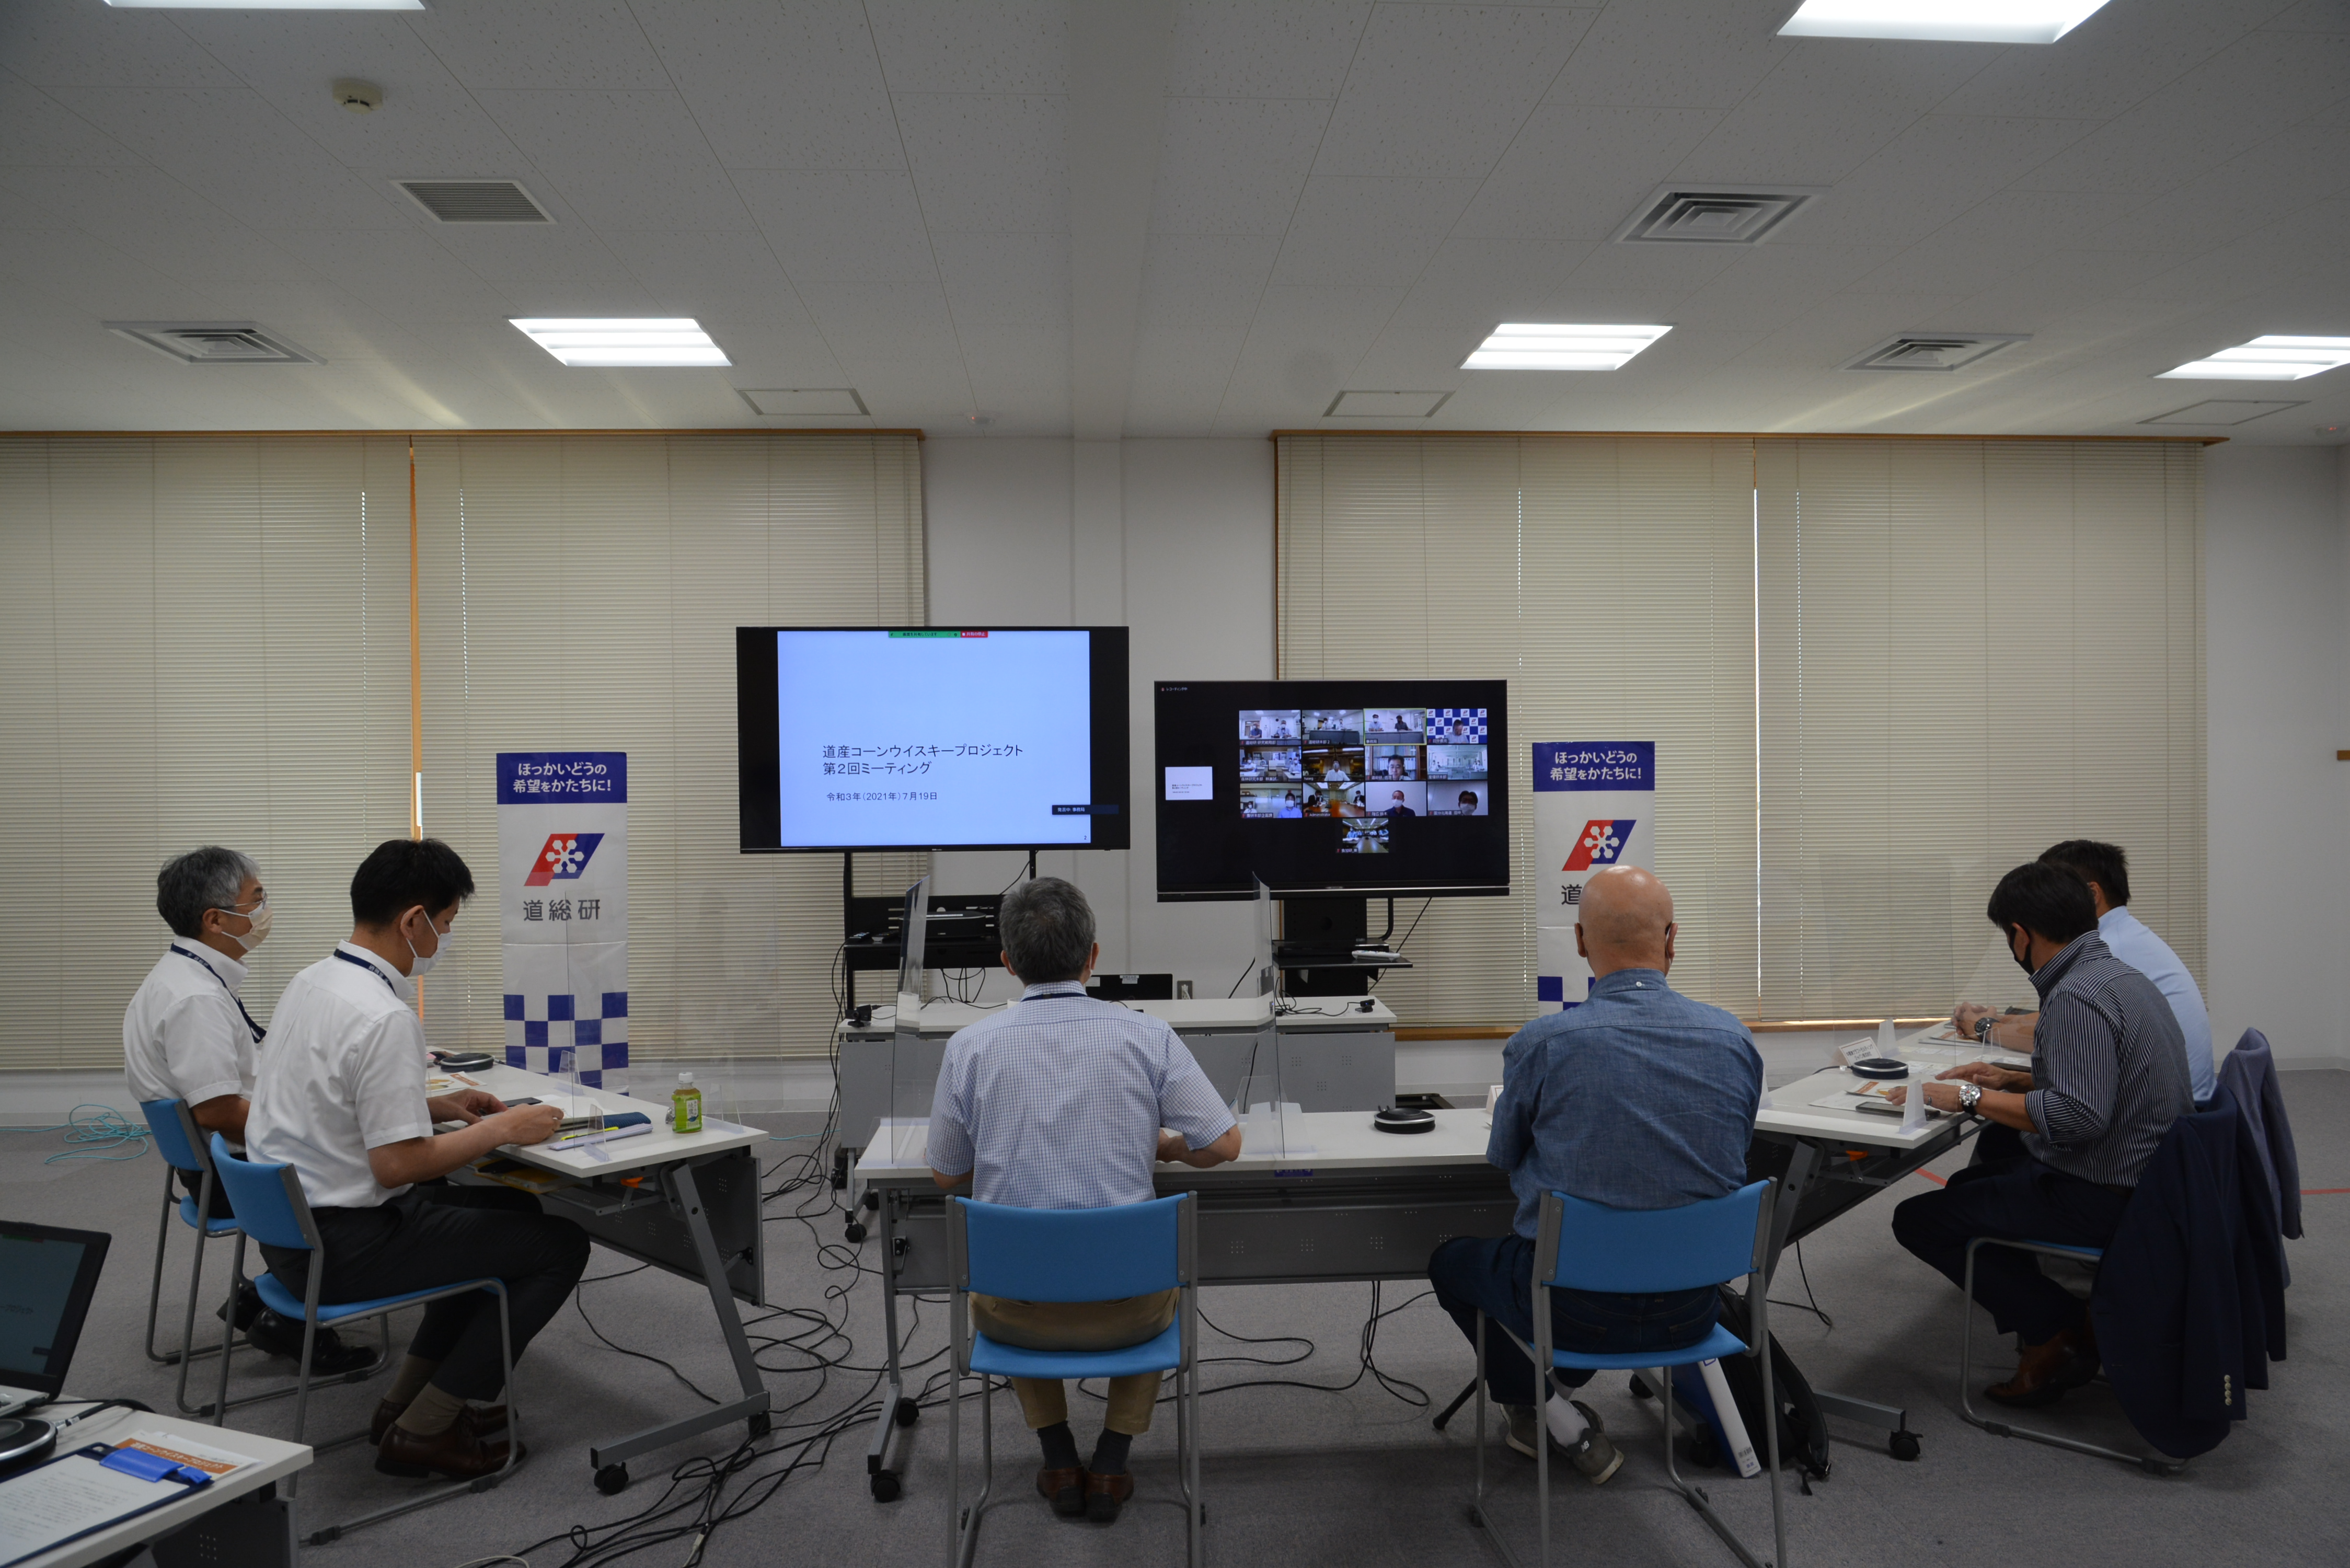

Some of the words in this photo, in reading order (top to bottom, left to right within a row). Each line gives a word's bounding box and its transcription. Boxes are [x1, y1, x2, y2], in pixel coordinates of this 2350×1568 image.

[823, 743, 1023, 759] 道産コーンウイスキープロジェクト
[1555, 750, 1637, 764] ほっかいどうの
[518, 762, 607, 776] ほっかいどうの
[523, 900, 600, 921] 道総研
